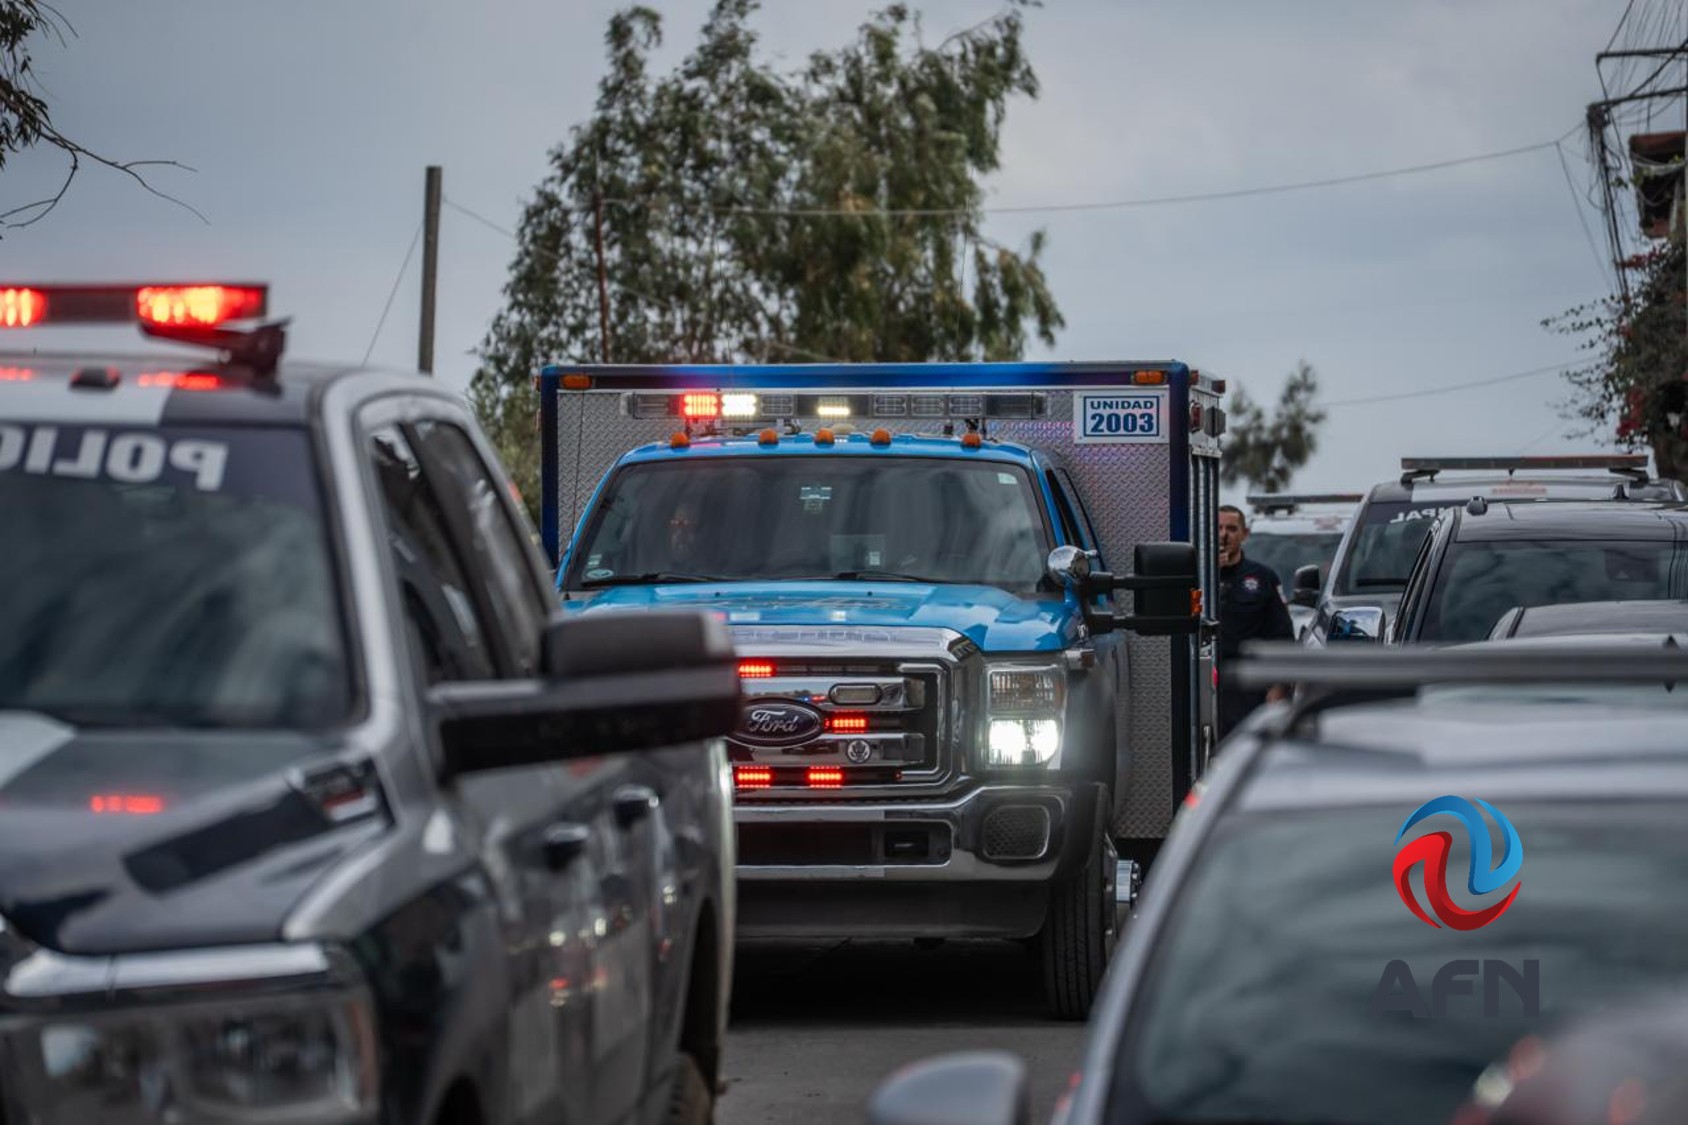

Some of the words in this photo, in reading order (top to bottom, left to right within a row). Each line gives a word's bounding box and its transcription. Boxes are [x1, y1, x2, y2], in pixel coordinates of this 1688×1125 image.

[1090, 400, 1154, 410] UNIDAD
[1090, 413, 1154, 433] 2003
[748, 709, 799, 732] Ford
